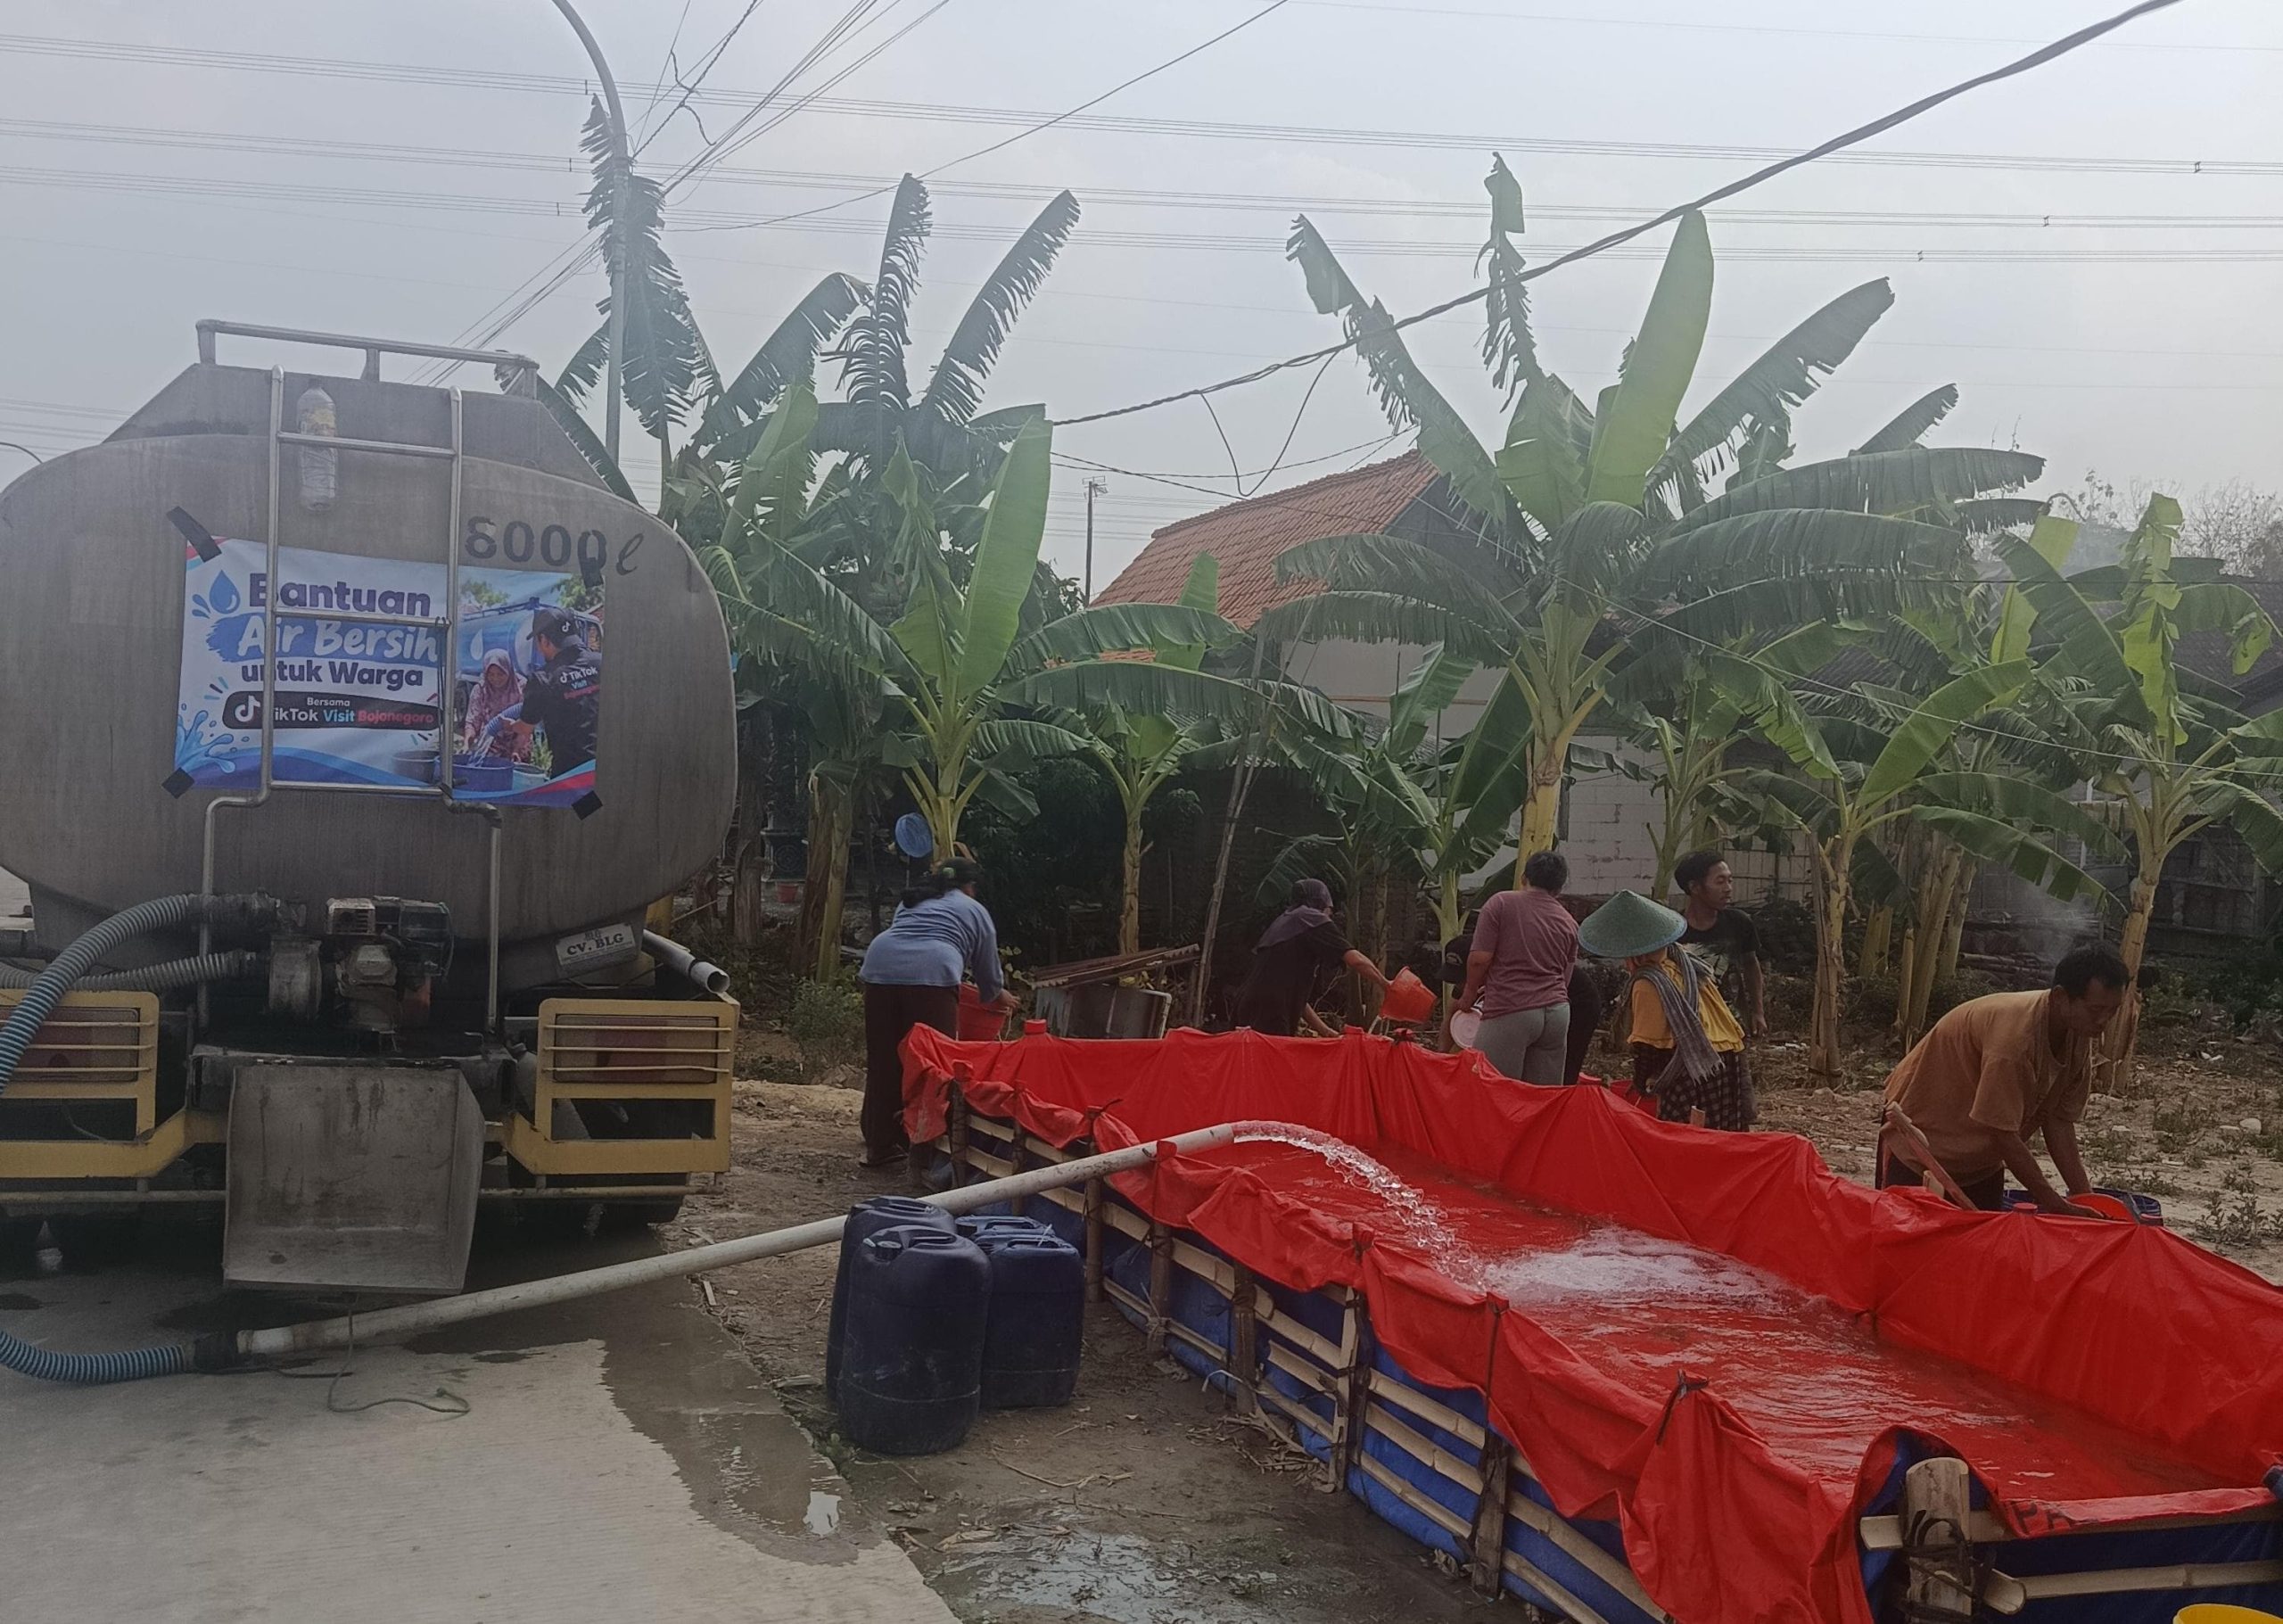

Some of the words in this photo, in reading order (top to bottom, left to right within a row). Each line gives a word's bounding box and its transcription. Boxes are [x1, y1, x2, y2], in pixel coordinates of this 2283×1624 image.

[249, 573, 431, 617] Bantuan
[314, 618, 438, 663] Bersih
[328, 660, 424, 692] Warga
[274, 707, 318, 721] ikTok
[323, 709, 355, 722] Visit
[307, 697, 350, 707] Bersama
